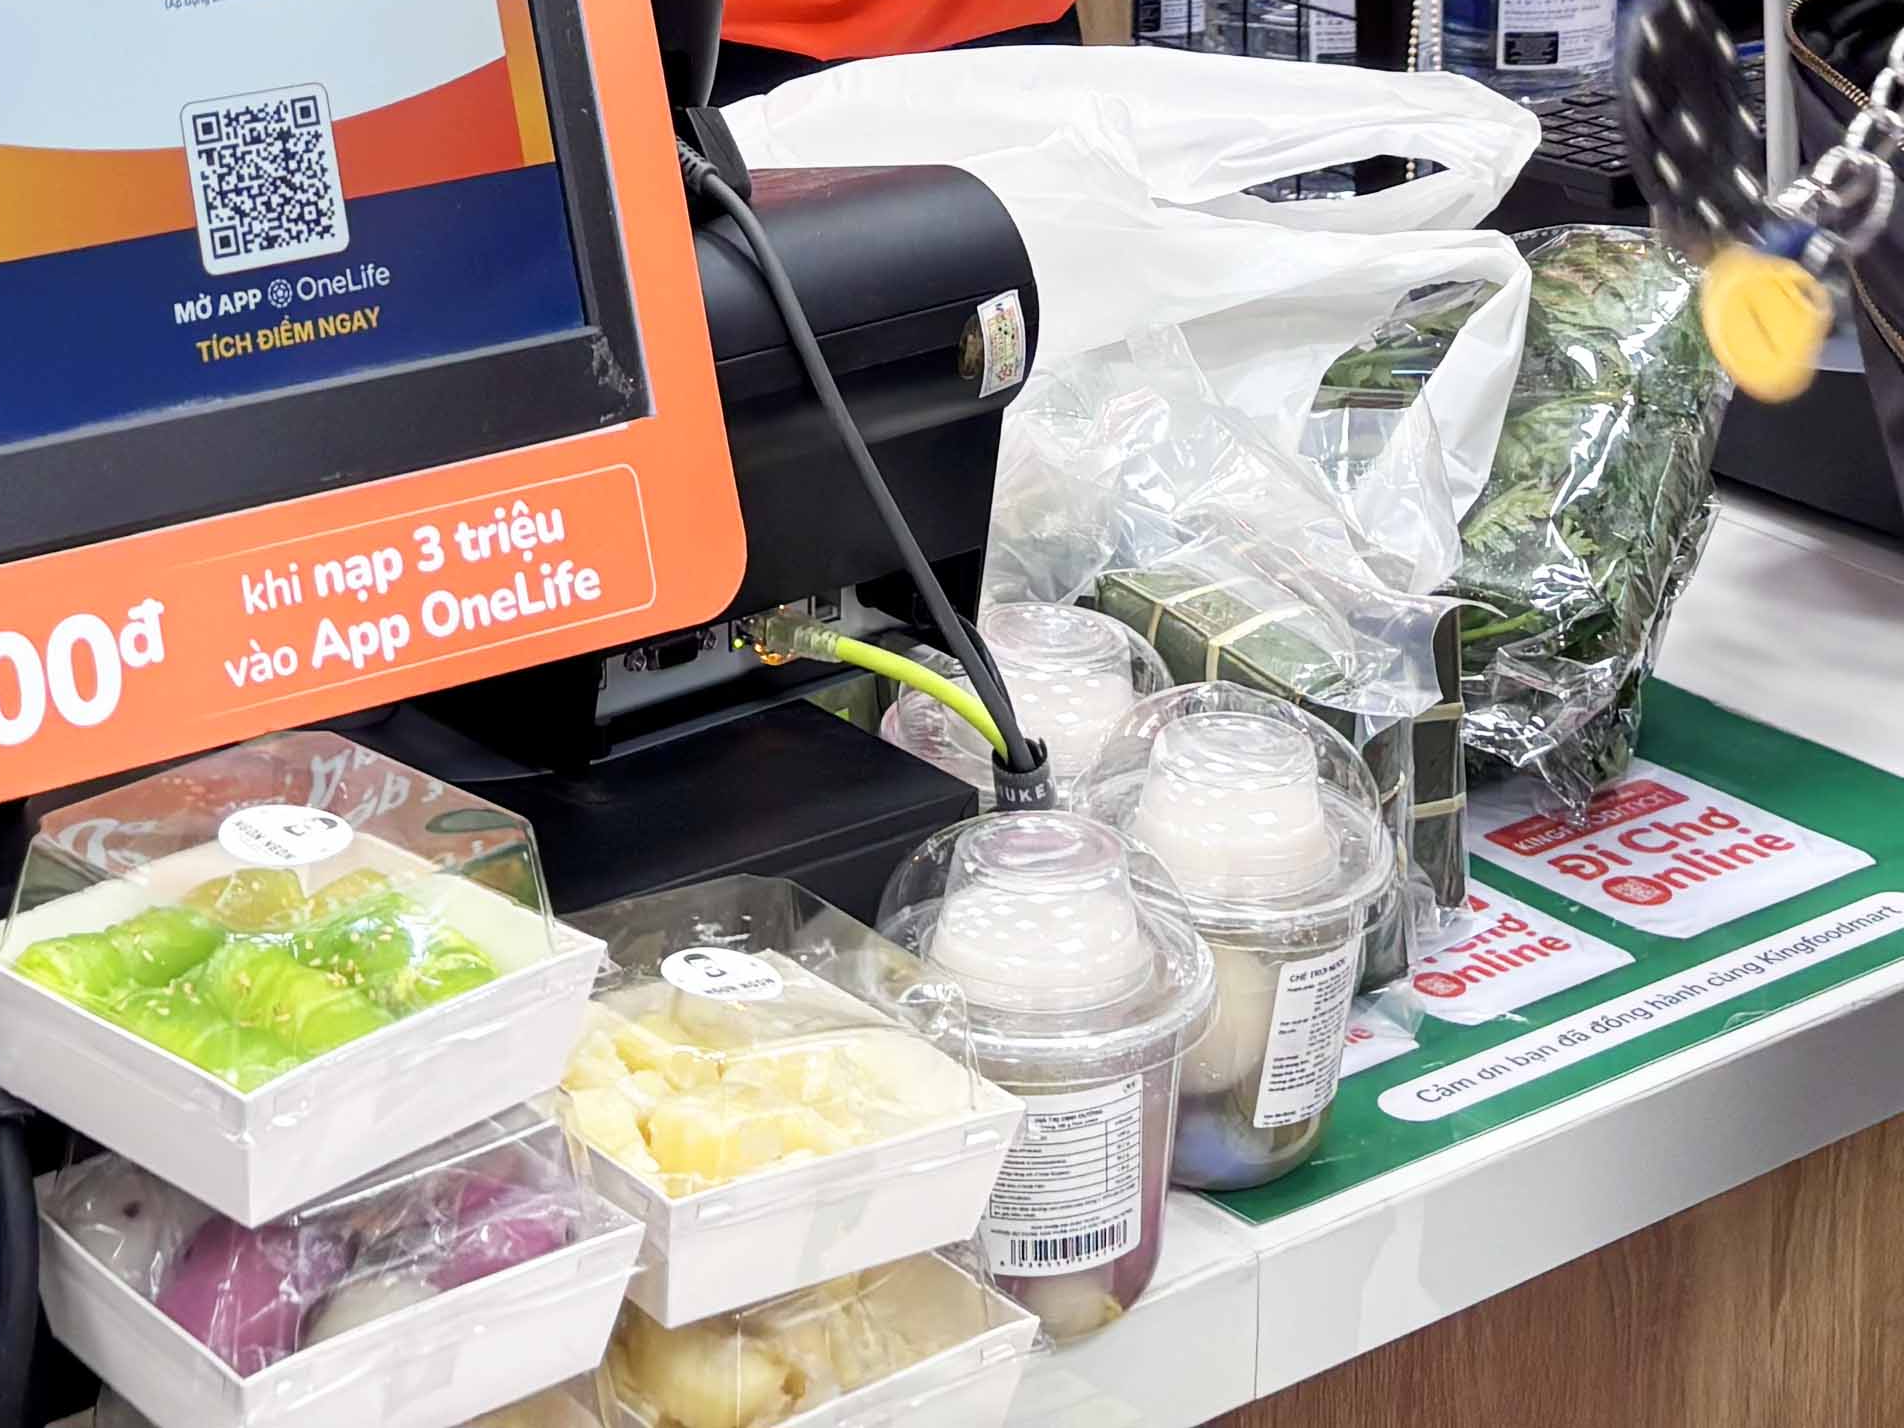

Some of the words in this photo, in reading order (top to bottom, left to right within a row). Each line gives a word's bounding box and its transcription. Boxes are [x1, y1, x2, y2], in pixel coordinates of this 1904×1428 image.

[242, 562, 302, 615] khi
[314, 546, 403, 602] nạp
[414, 524, 446, 573] 3
[454, 499, 566, 563] triệu
[224, 639, 298, 688] vào
[311, 612, 410, 670] App
[421, 560, 601, 638] OneLife
[1416, 1072, 1475, 1105] Cảm
[1506, 1039, 1558, 1069] bạn
[1558, 1020, 1591, 1049] đã
[1591, 999, 1650, 1039] đồng
[1648, 979, 1708, 1014] hành
[1707, 959, 1763, 993] cùng
[1760, 902, 1902, 972] Kingfoodmart
